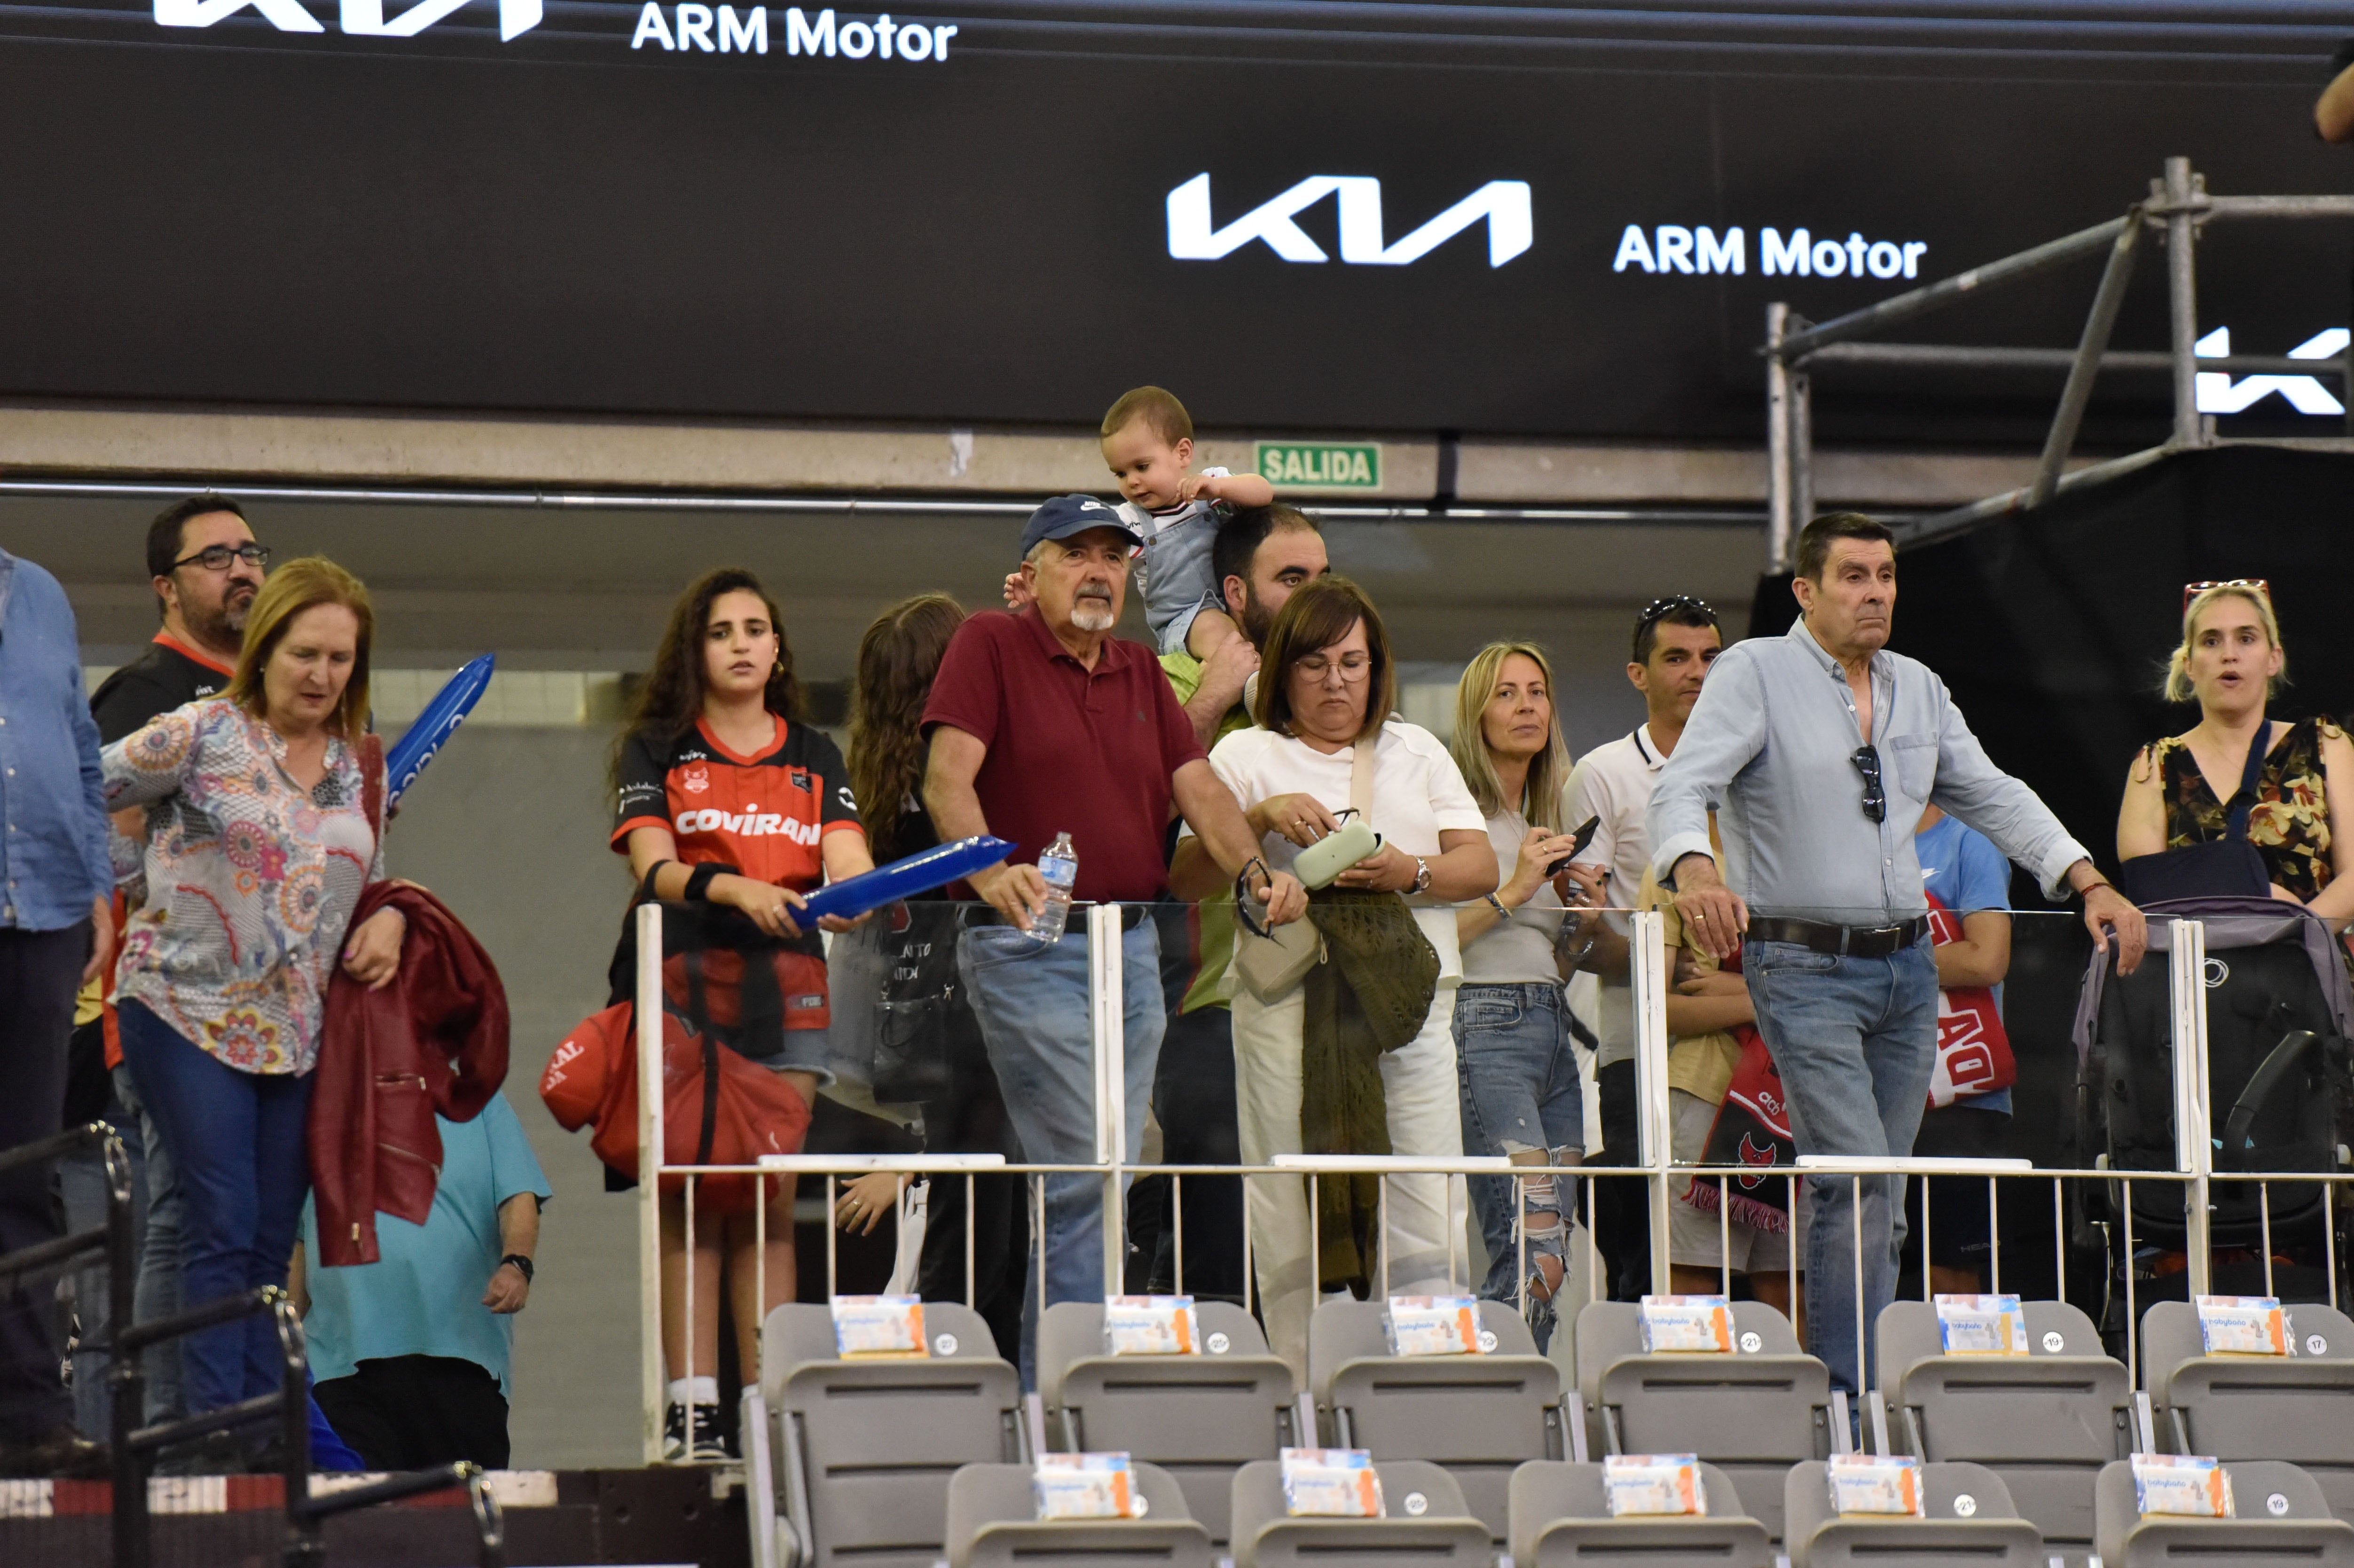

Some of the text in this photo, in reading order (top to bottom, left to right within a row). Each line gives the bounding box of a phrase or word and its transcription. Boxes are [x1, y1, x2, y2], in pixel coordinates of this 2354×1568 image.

[630, 1, 957, 61] ARM Motor
[1613, 224, 1927, 279] ARM Motor
[1264, 449, 1372, 483] SALIDA
[2048, 1337, 2060, 1346] 19
[2311, 1340, 2322, 1349] 17
[2272, 1499, 2284, 1509] 19
